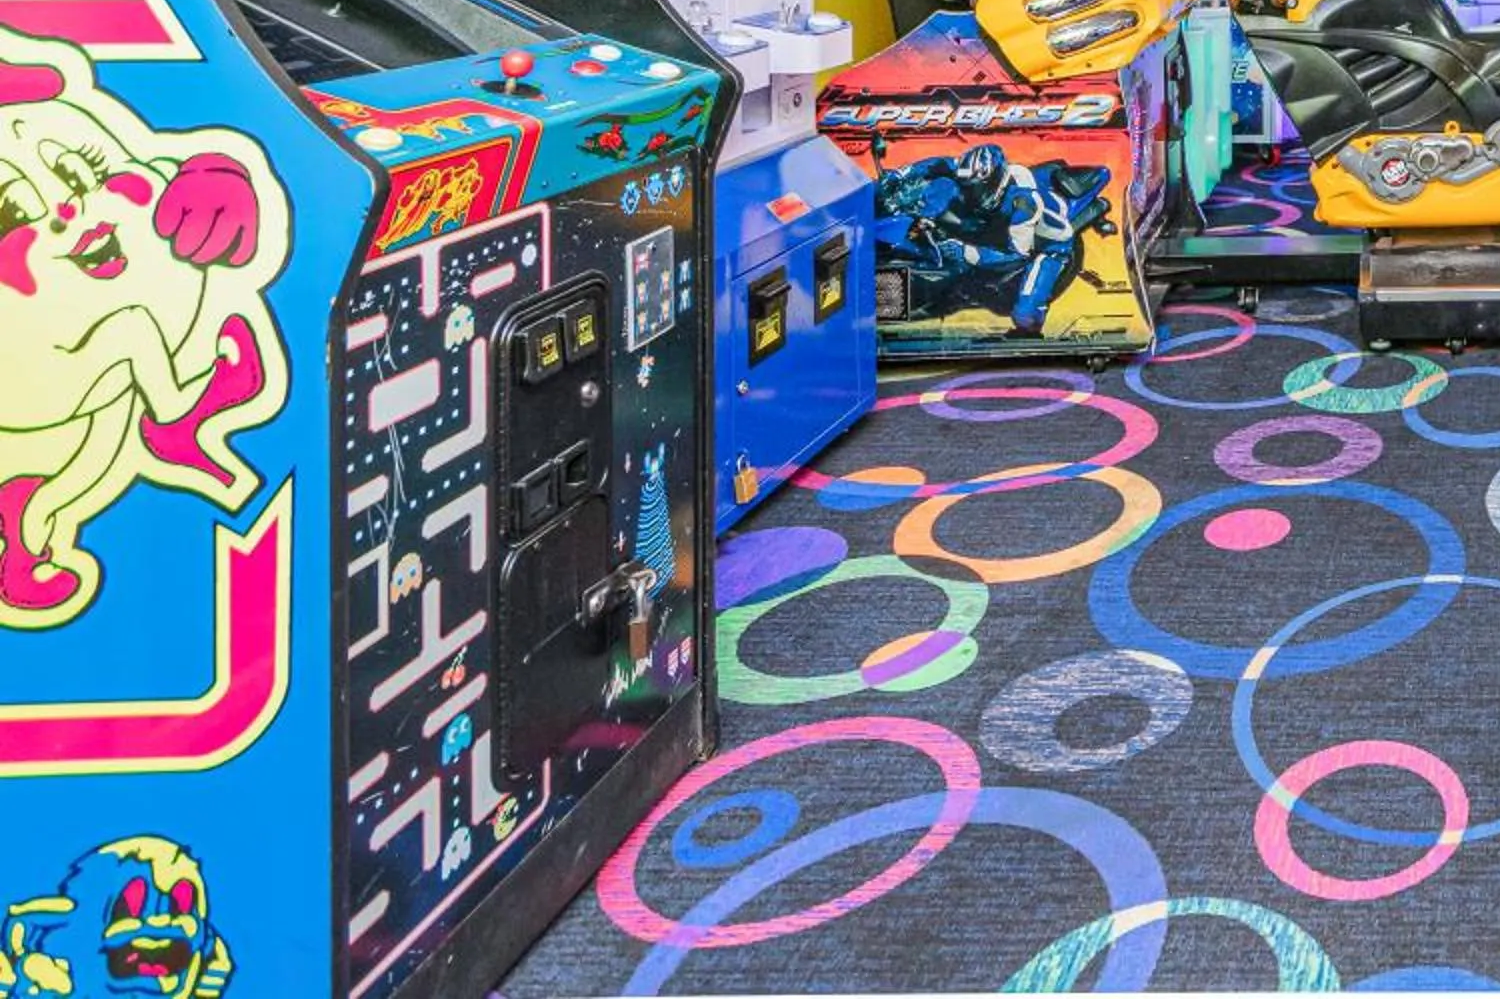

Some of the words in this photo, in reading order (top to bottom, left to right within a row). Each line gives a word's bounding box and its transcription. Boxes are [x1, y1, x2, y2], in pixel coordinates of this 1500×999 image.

[820, 104, 951, 128] SUPER
[951, 103, 1063, 128] BIKES
[1063, 93, 1117, 126] 2
